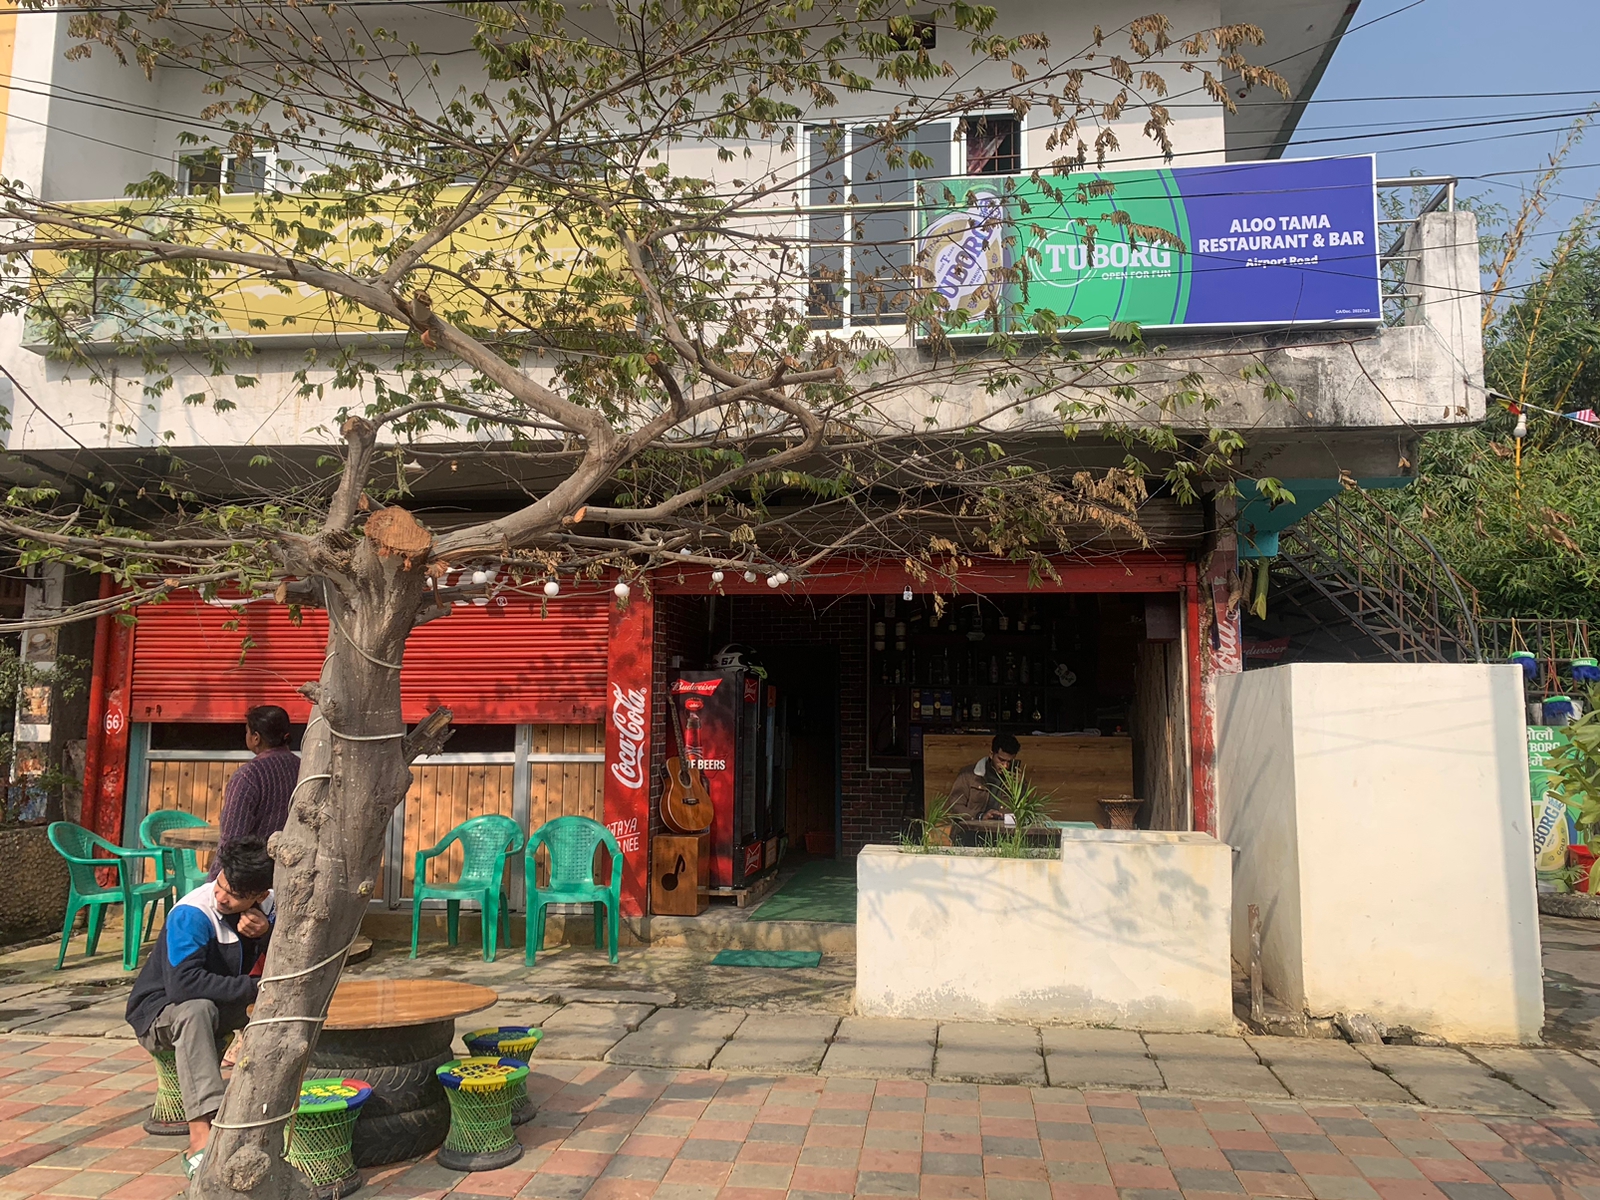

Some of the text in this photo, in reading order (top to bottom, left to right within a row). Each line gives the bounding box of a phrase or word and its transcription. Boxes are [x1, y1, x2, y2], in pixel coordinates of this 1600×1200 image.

[1229, 214, 1331, 233] ALOO TAMA
[1198, 230, 1365, 253] RESTAURANT & BAR
[1045, 238, 1171, 273] TUBORG
[1245, 254, 1319, 269] Airport Road
[1101, 269, 1171, 280] OPEN FOR FUN
[670, 681, 717, 692] Budweiser
[611, 681, 647, 789] Coca-Cola
[697, 759, 726, 771] BEERS
